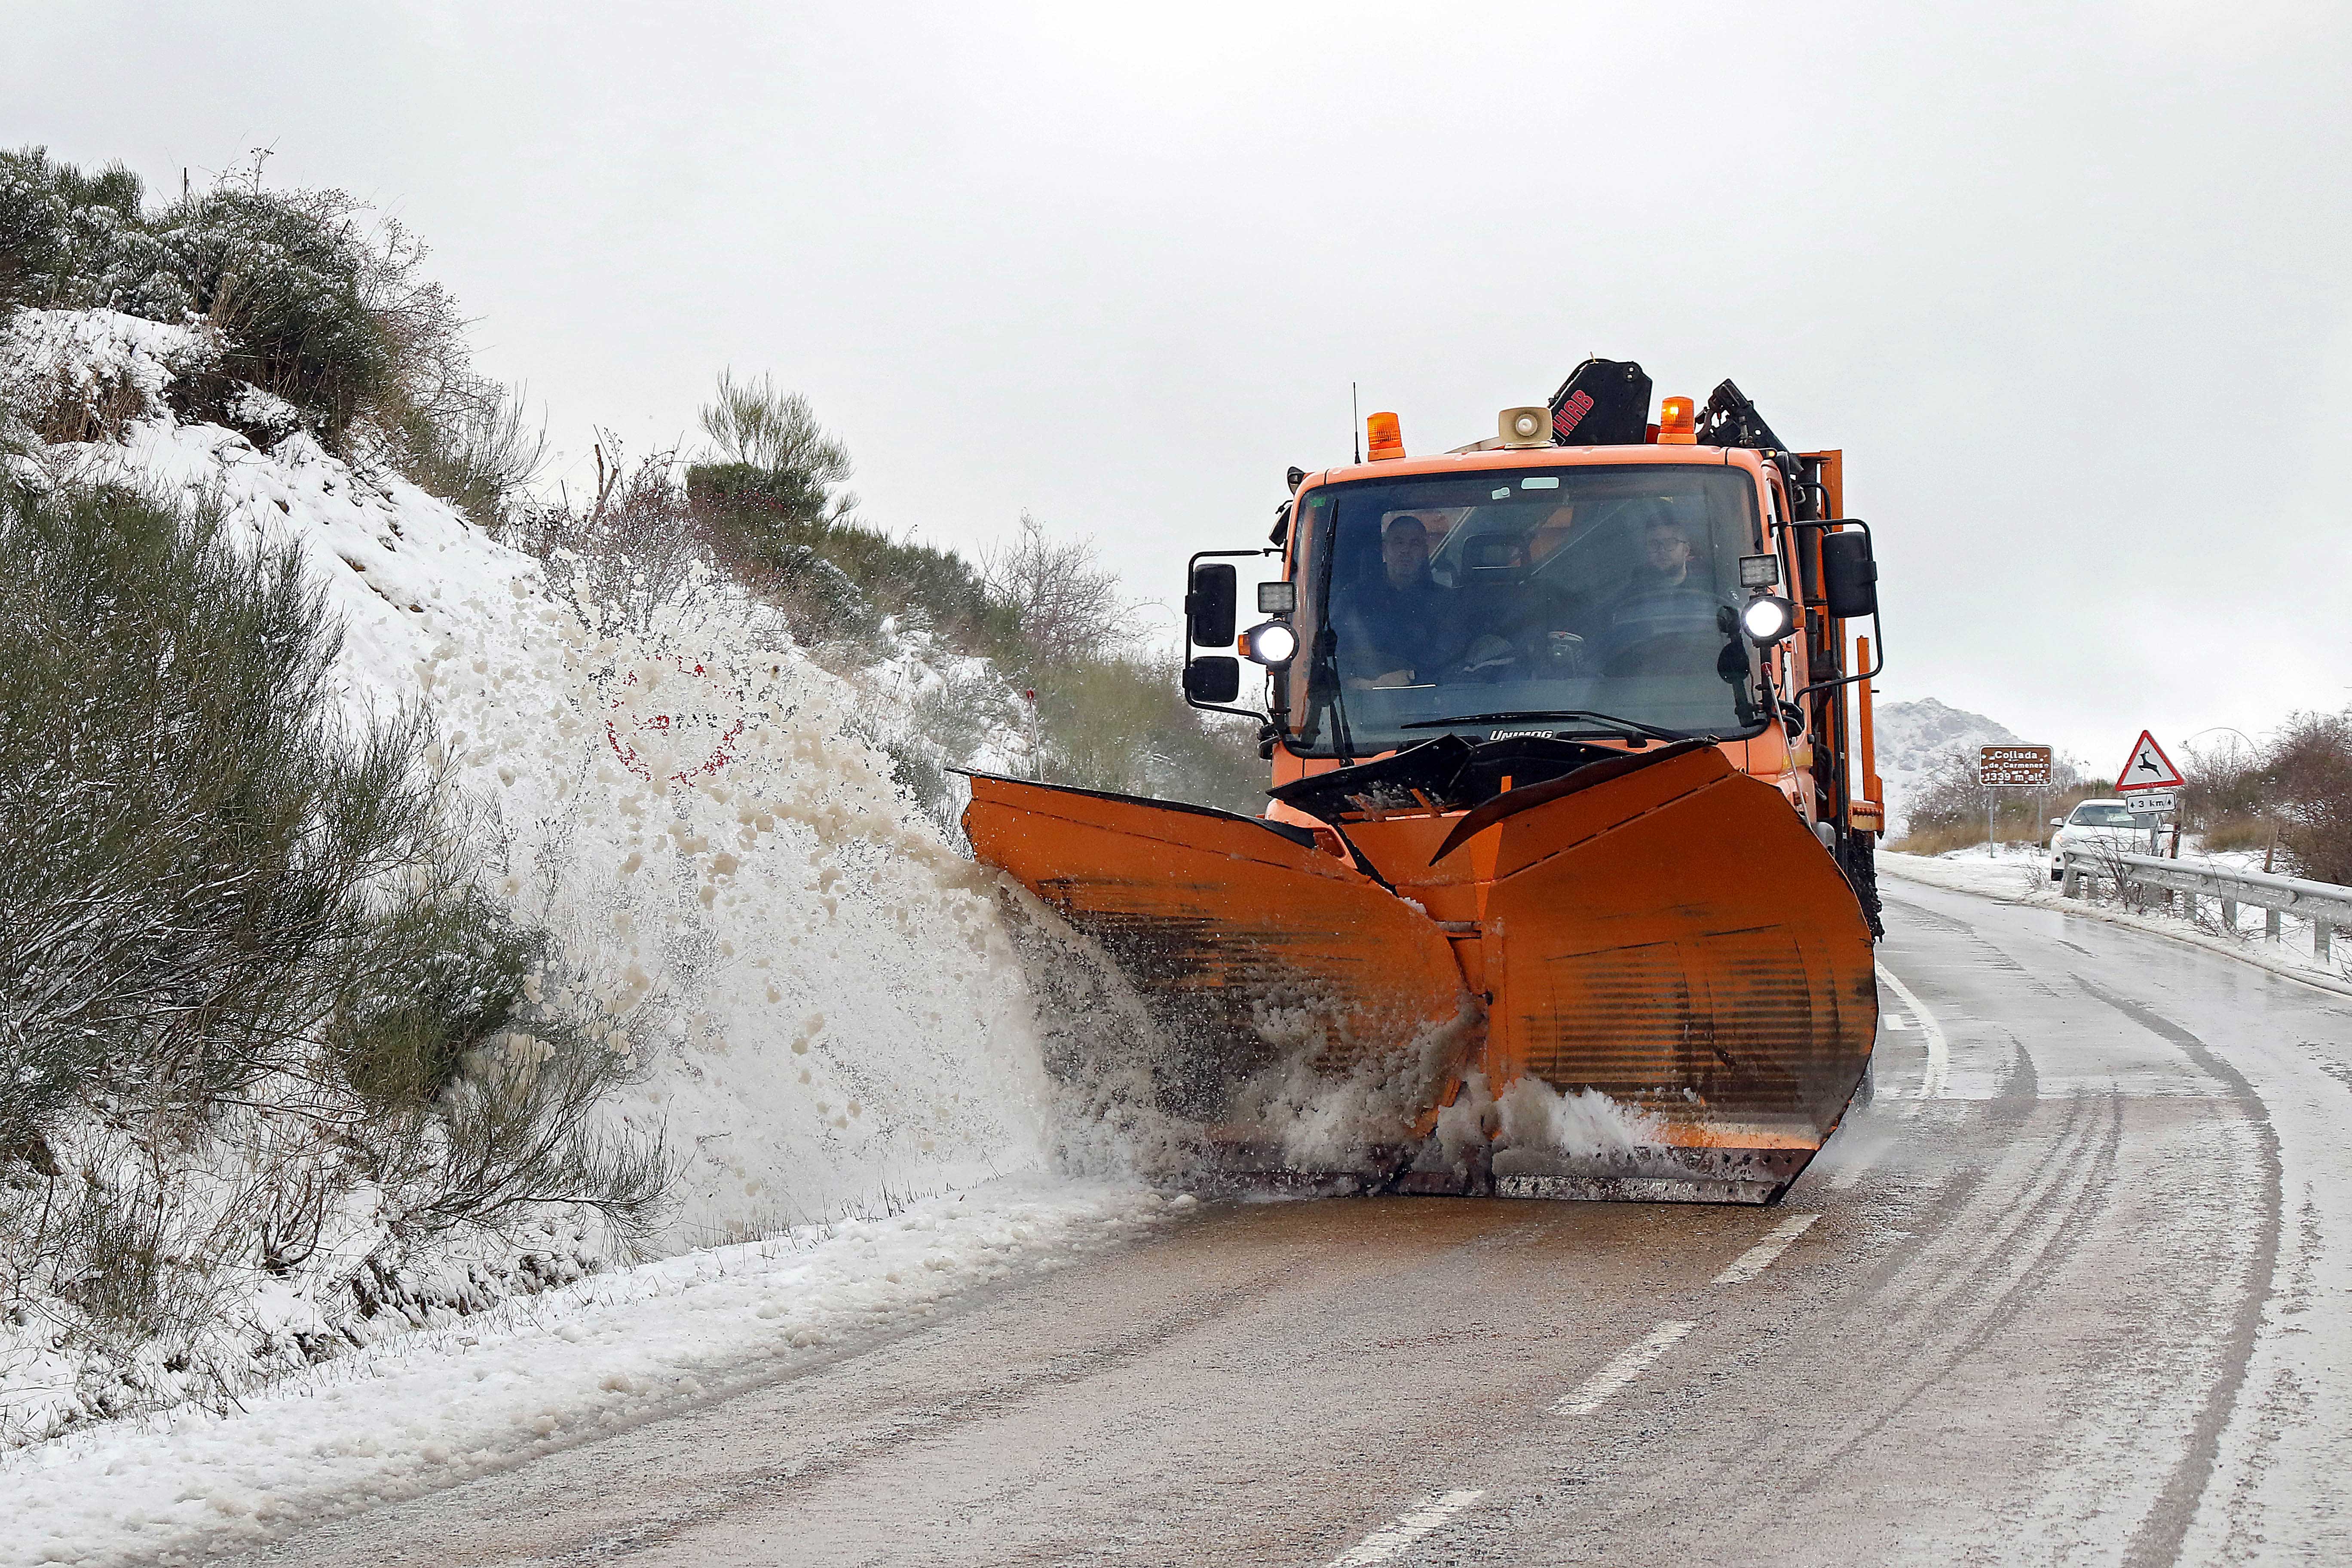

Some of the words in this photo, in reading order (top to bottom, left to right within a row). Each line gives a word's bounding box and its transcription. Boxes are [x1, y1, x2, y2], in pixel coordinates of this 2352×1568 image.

[1553, 390, 1594, 436] HIAB
[1995, 750, 2037, 759] Collada
[1985, 772, 2011, 781] 1339
[2028, 773, 2046, 781] alt.
